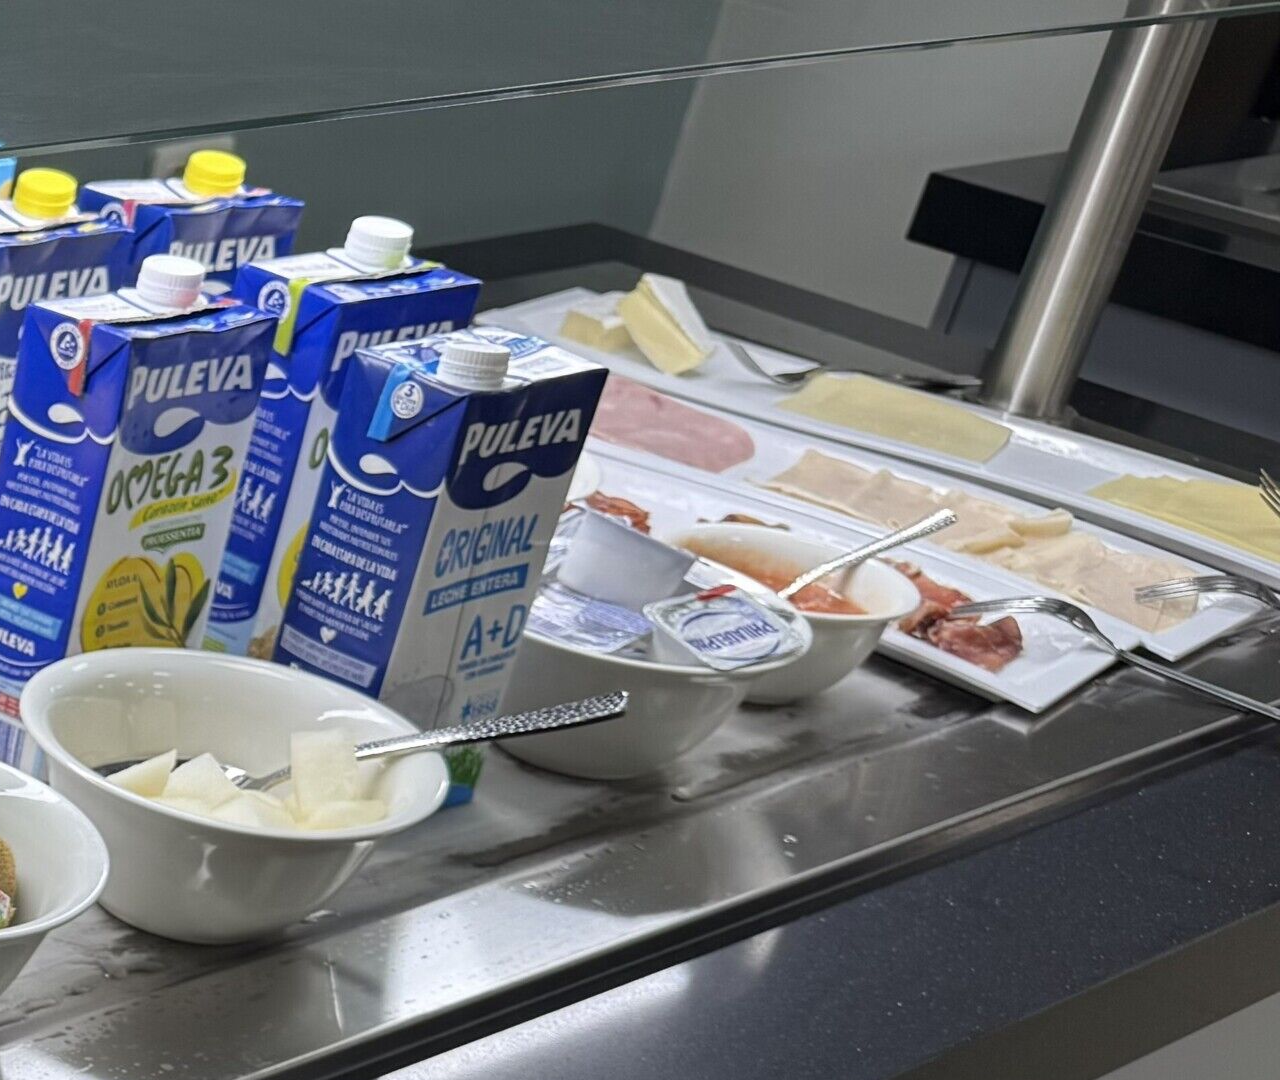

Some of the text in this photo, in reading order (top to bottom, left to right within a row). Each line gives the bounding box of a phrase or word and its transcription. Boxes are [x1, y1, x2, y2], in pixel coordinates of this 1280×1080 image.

[127, 354, 254, 411] PULEVA
[459, 408, 582, 466] PULEVA
[106, 448, 205, 515] OMEGA
[208, 445, 234, 490] 3
[434, 513, 539, 579] ORIGINAL
[471, 571, 520, 597] ENTERA
